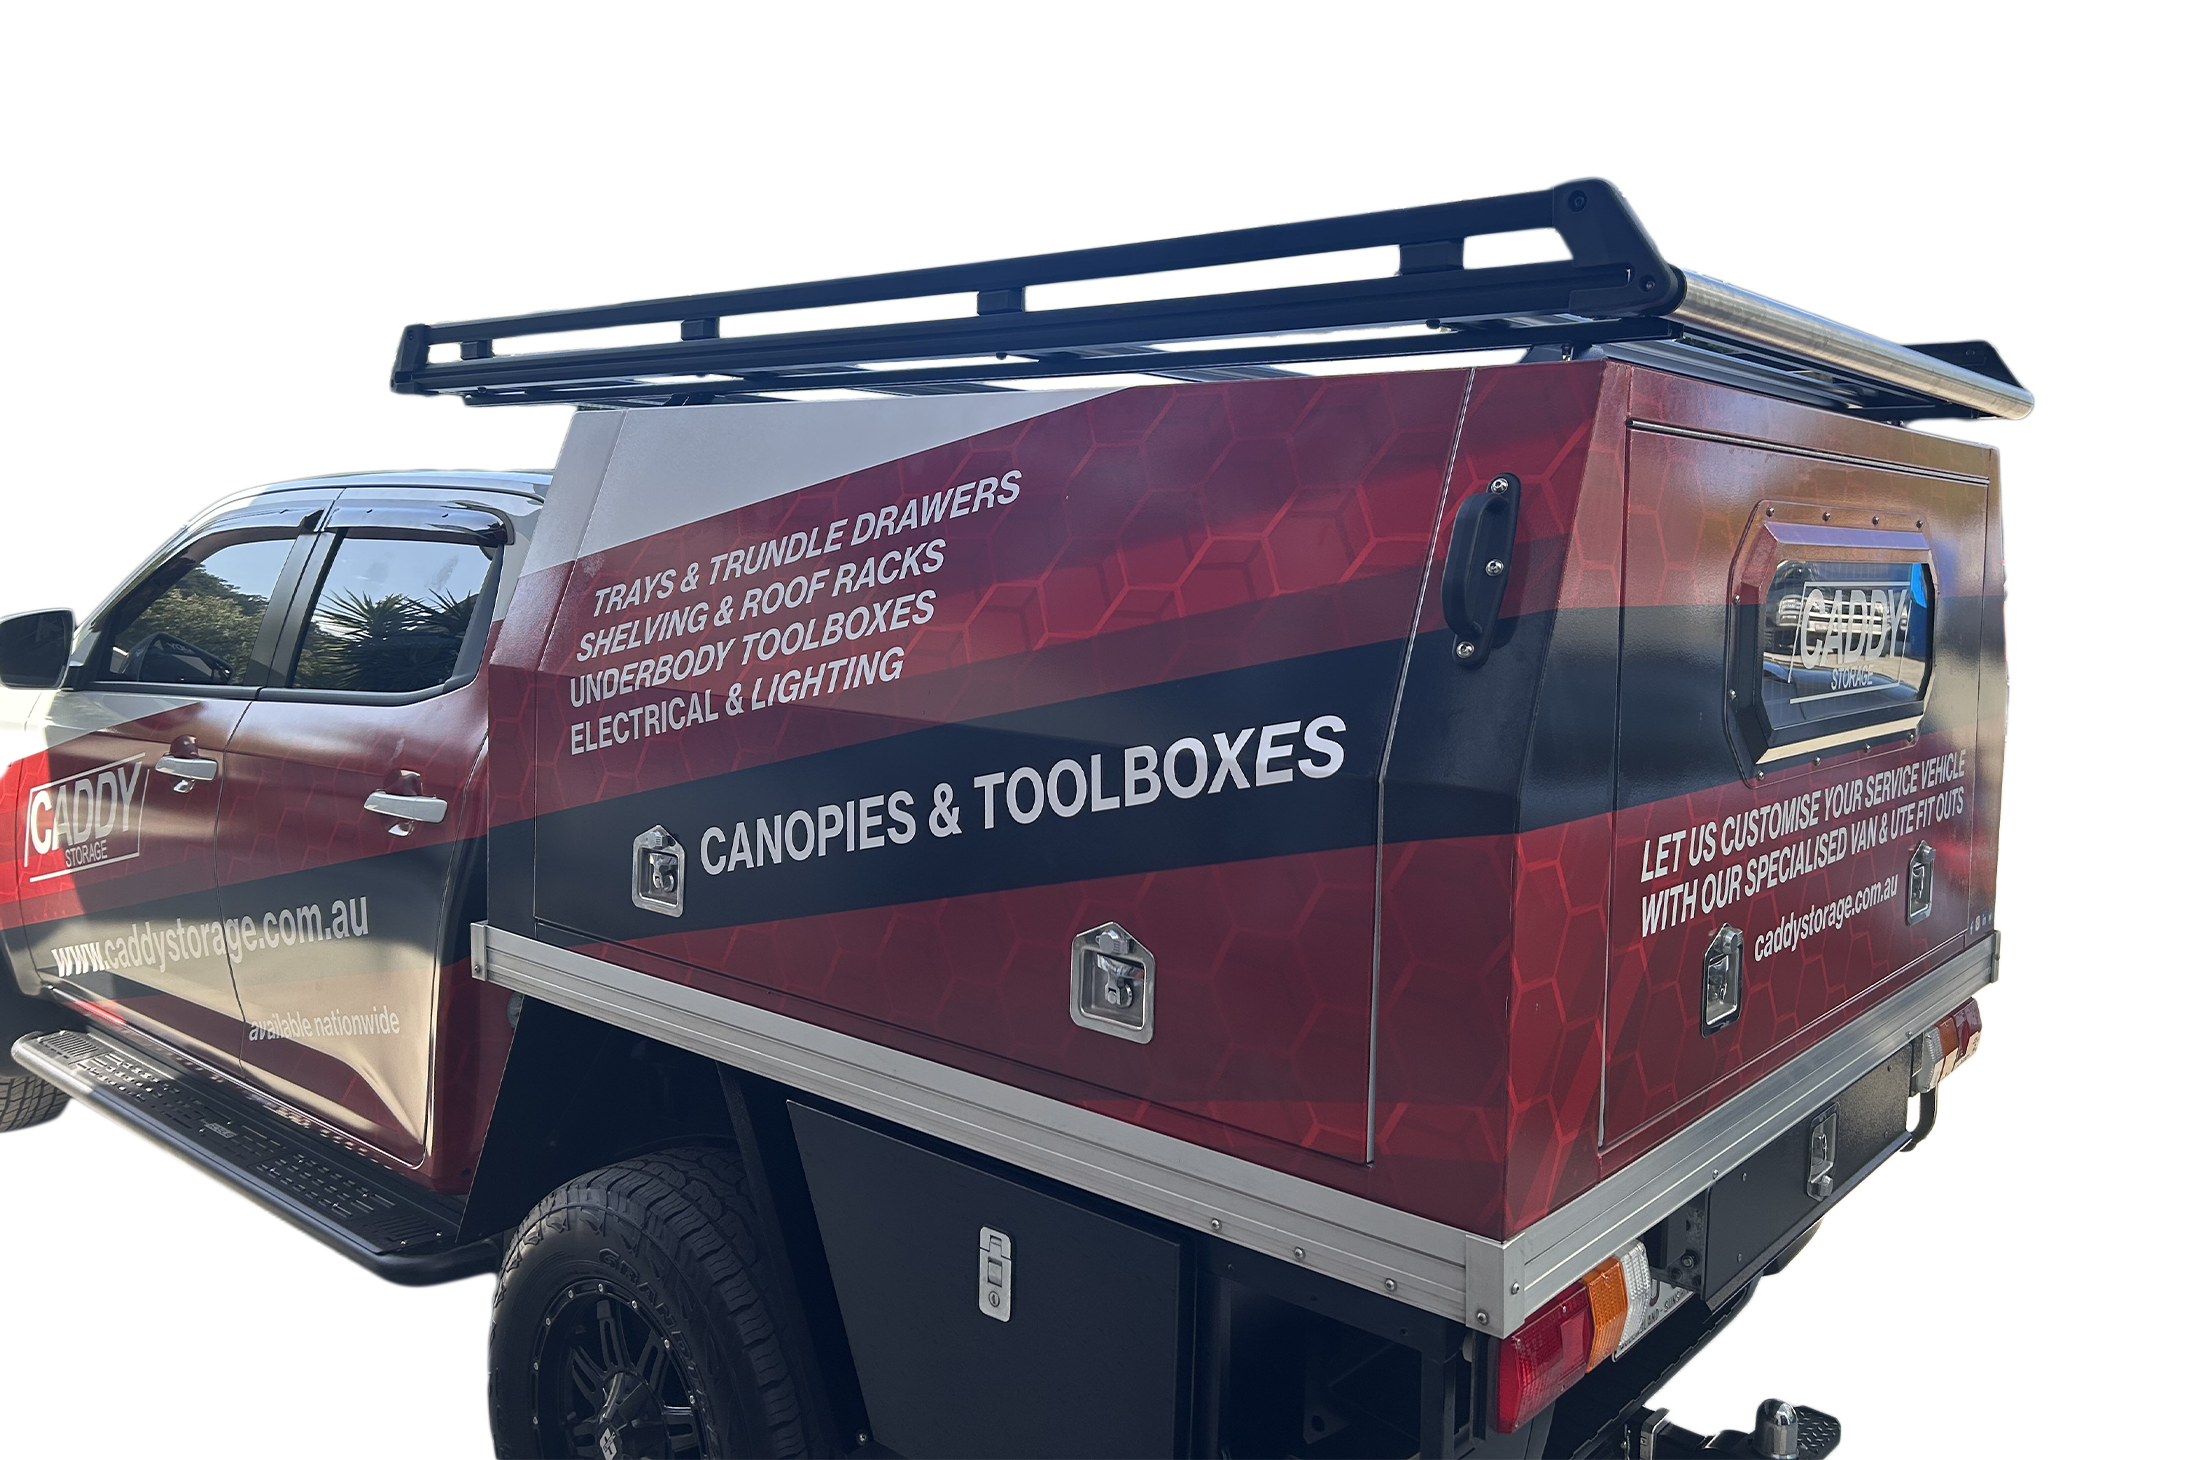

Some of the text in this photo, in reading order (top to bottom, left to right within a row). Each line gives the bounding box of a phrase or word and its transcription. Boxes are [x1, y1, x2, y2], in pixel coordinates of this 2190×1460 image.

[594, 469, 1023, 617] TRAYS & TRUNDLE DRAWERS
[571, 589, 937, 708] UNDERBODY TOOLBOXES
[577, 538, 946, 662] SHELVING & ROOF RACKS
[1800, 588, 1908, 670] CADDY
[571, 646, 905, 755] ELECTRICAL & LIGHTING
[1830, 664, 1874, 691] STORAGE
[30, 761, 143, 855] CADDY
[701, 715, 1347, 876] CANOPIES & TOOLBOXES
[1641, 749, 1966, 883] LET US CUSTOMISE YOUR SERVICE VEHICLE
[65, 839, 108, 868] STORAGE
[1641, 786, 1964, 938] WITH OUR SPECIALISED VAN & UTE FIT OUTS
[51, 896, 370, 978] www.caddystorage.com.au
[1754, 874, 1898, 962] caddystorage.com.au
[249, 1006, 400, 1041] available nationwide
